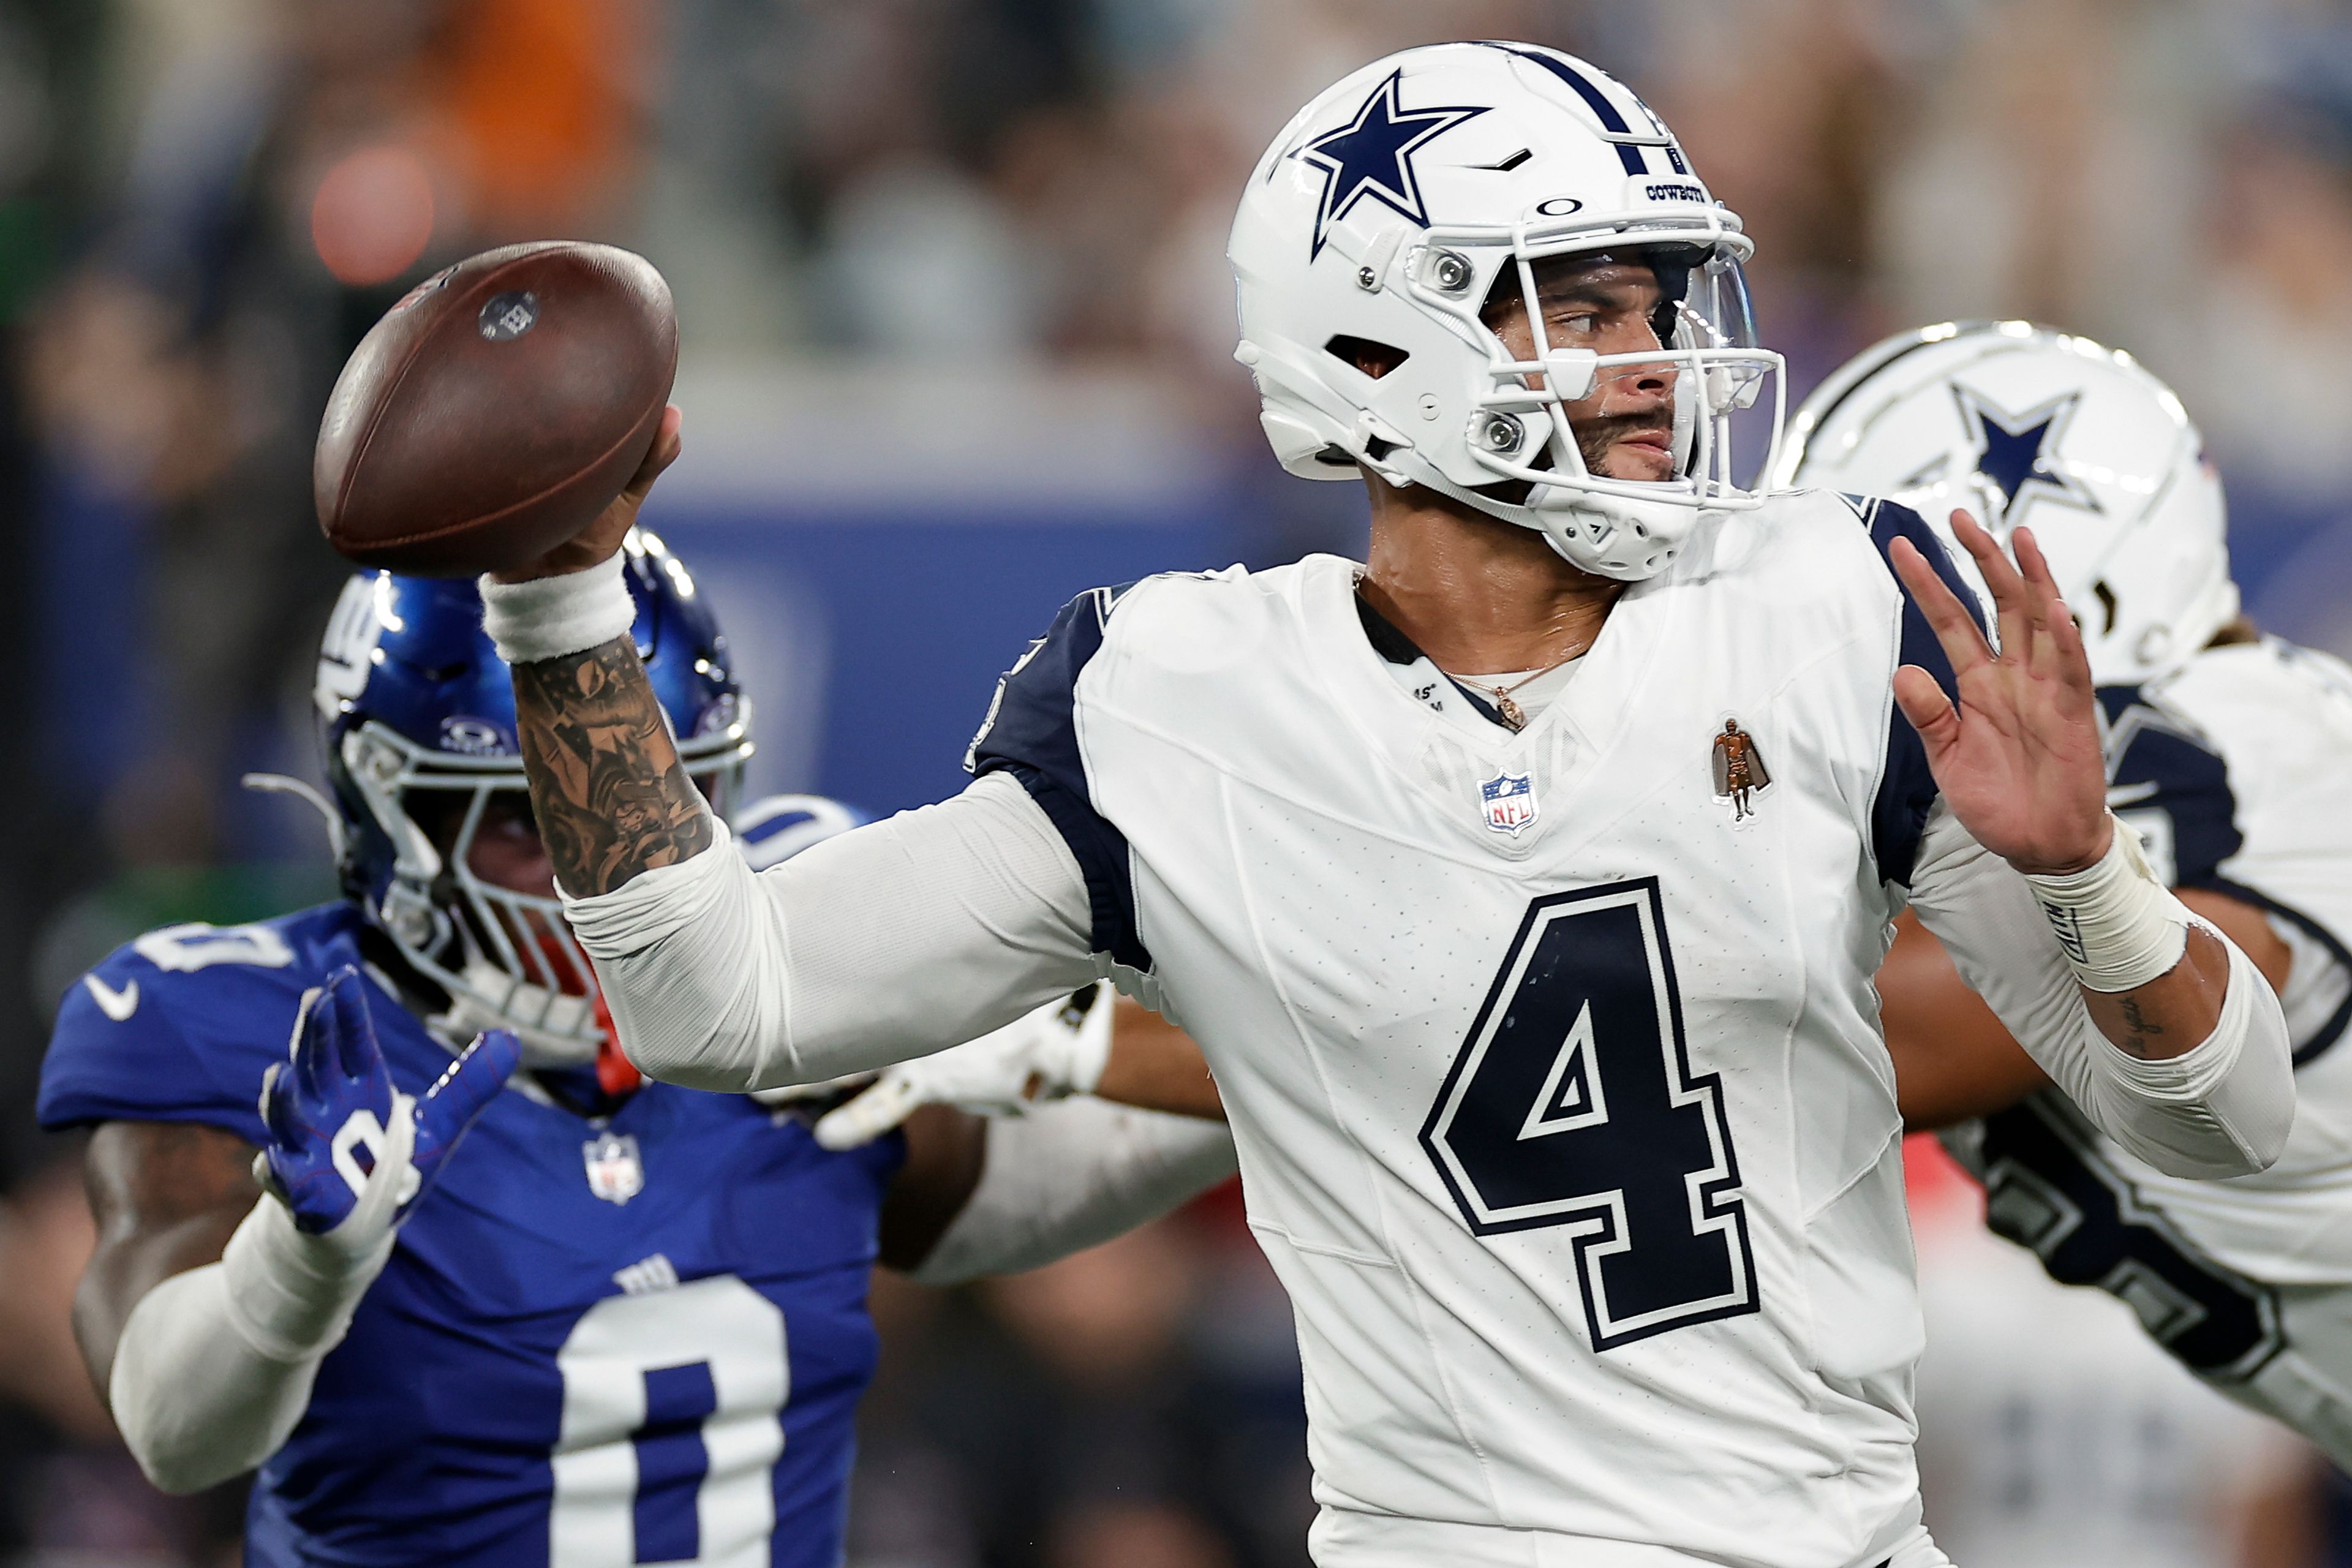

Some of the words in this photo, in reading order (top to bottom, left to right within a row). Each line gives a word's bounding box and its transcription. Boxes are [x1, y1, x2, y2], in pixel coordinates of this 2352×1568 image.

[1490, 799, 1529, 824] NFL
[1417, 875, 1761, 1354] 4
[548, 1273, 790, 1568] 0
